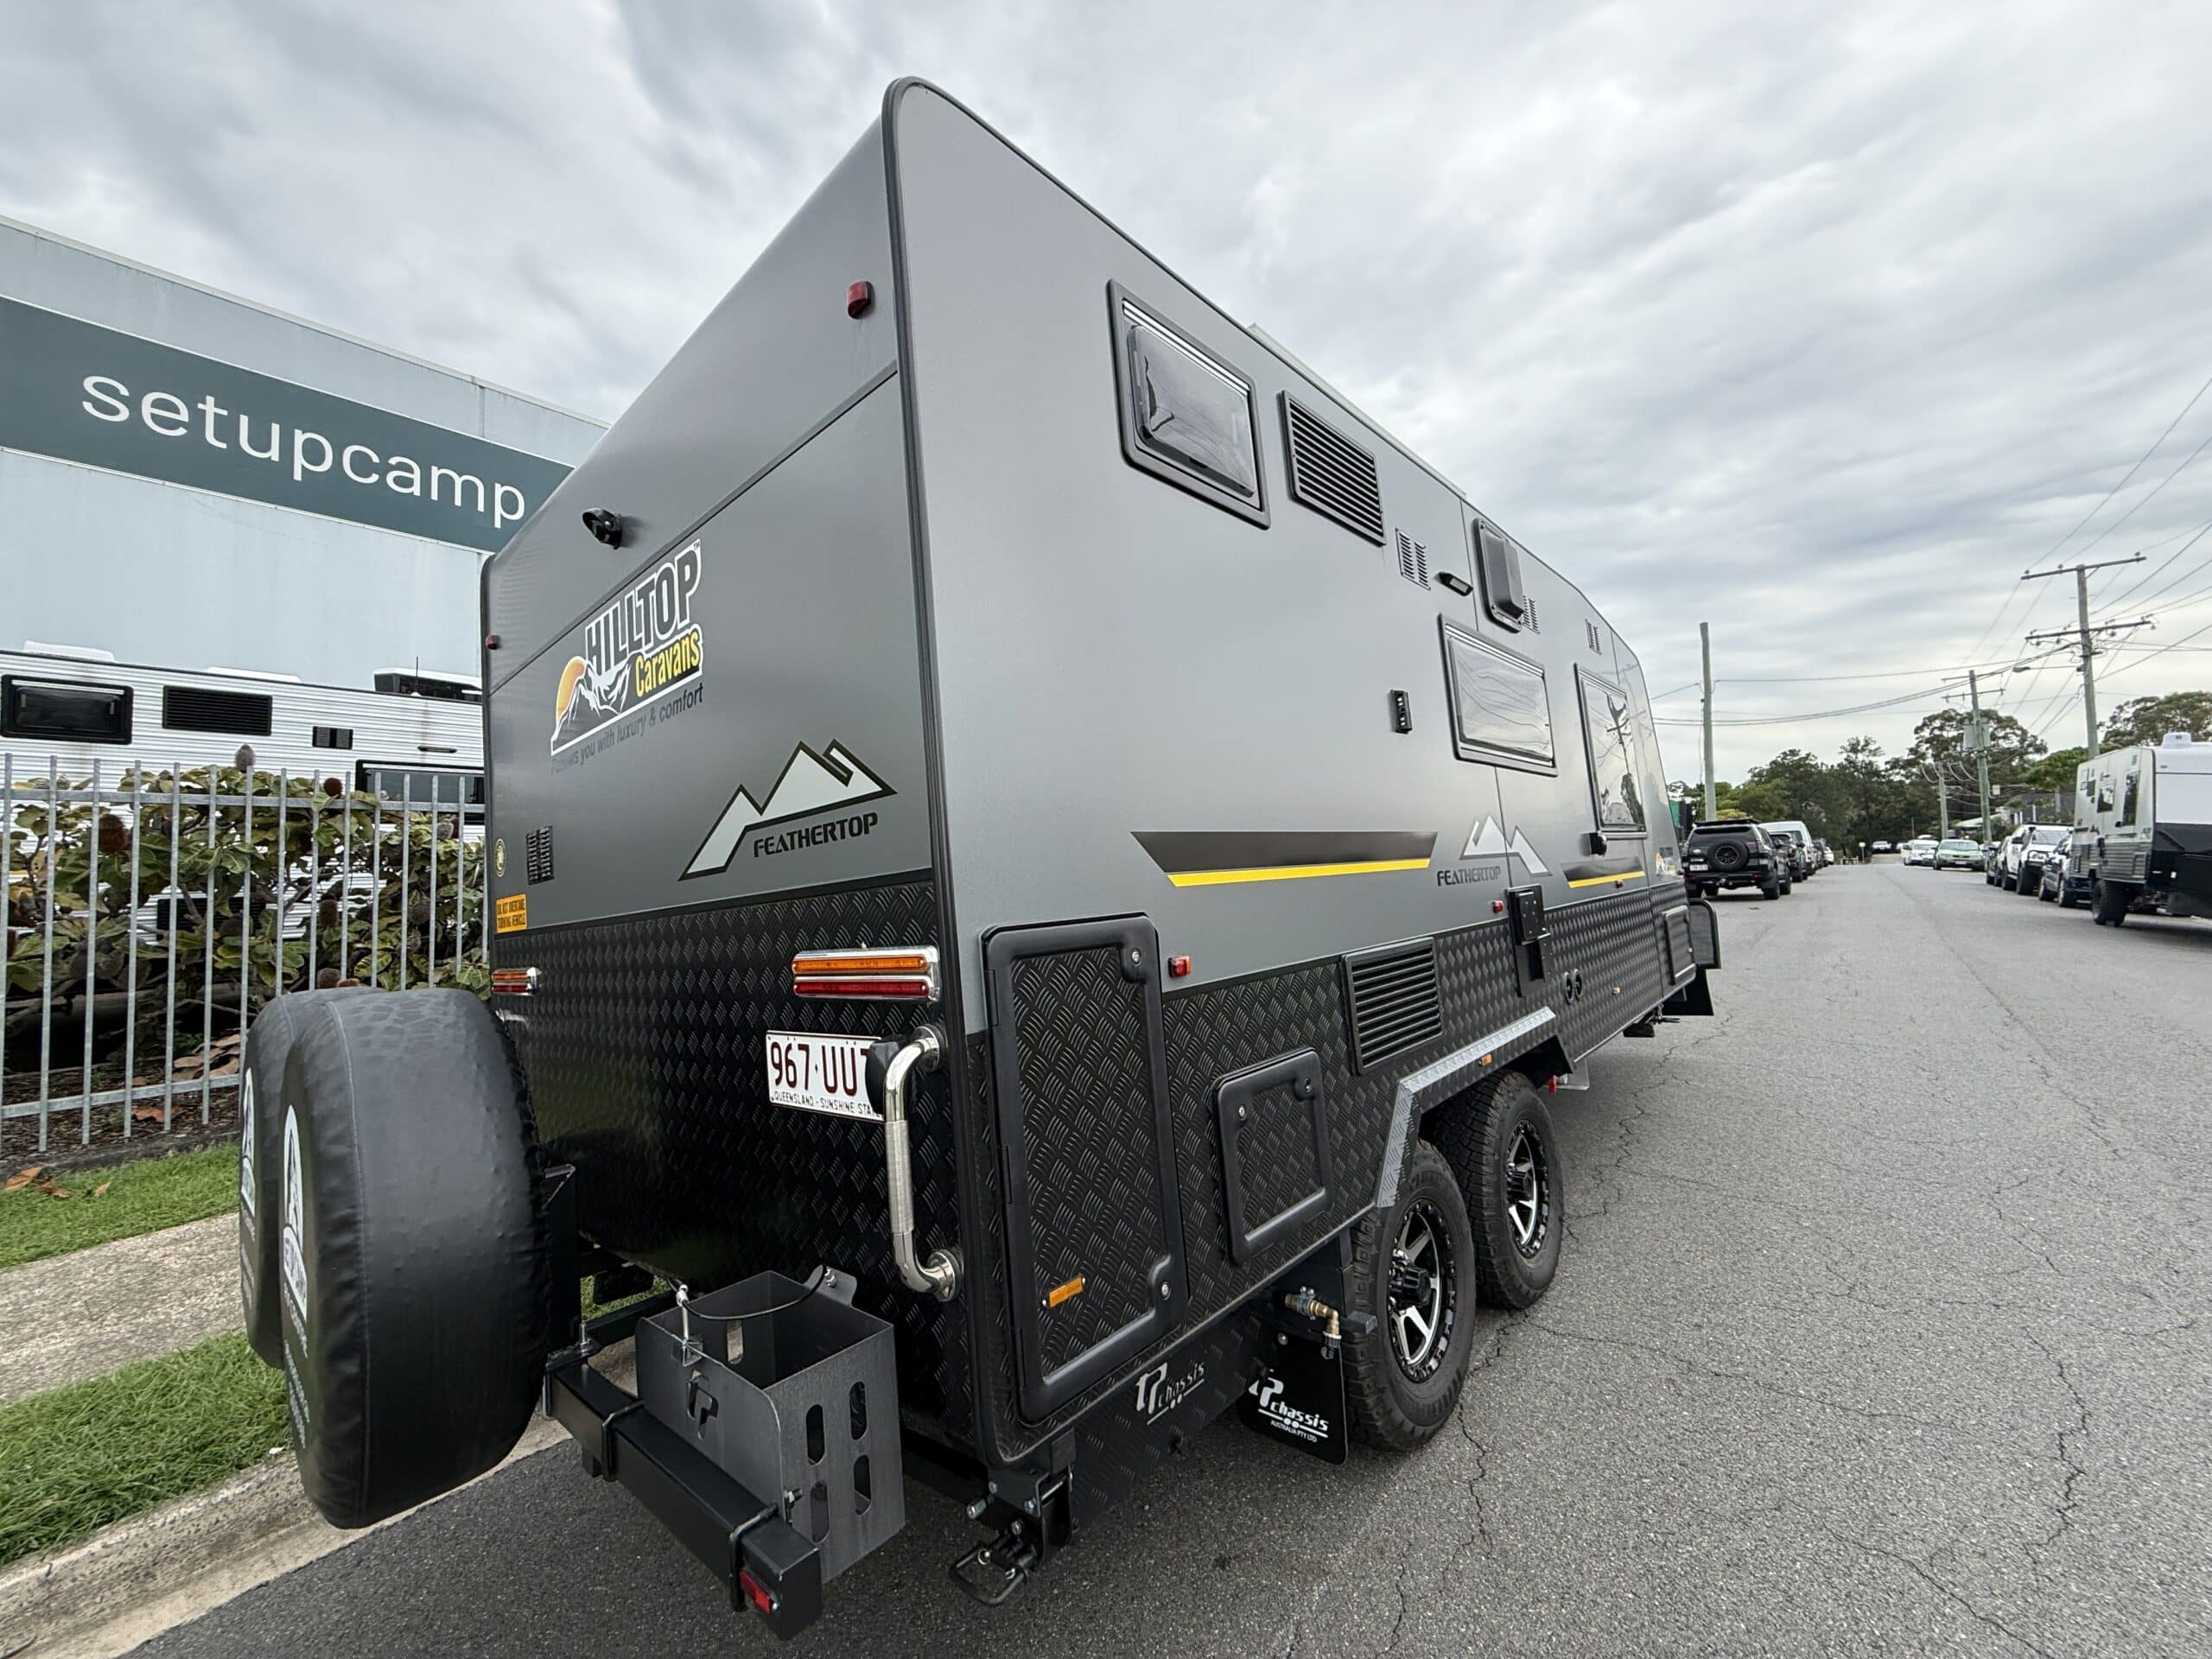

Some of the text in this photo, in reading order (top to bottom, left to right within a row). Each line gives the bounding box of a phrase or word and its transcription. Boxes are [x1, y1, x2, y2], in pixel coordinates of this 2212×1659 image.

[82, 375, 525, 529] setupcamp
[585, 546, 702, 677] HILLTOP
[635, 630, 700, 697] Caravans
[580, 741, 595, 766] you
[597, 731, 615, 753] with
[617, 714, 646, 744] luxury
[649, 707, 657, 728] &
[659, 683, 704, 722] comfort
[753, 811, 878, 857] FEATHERTOP
[1437, 866, 1501, 887] FEATHERTOP
[774, 1090, 814, 1107] QUEENSLAND
[820, 1097, 855, 1113] SUNSHINE
[1270, 1401, 1329, 1431] chassis
[1270, 1419, 1318, 1443] AUSTRALIA PTY LTD
